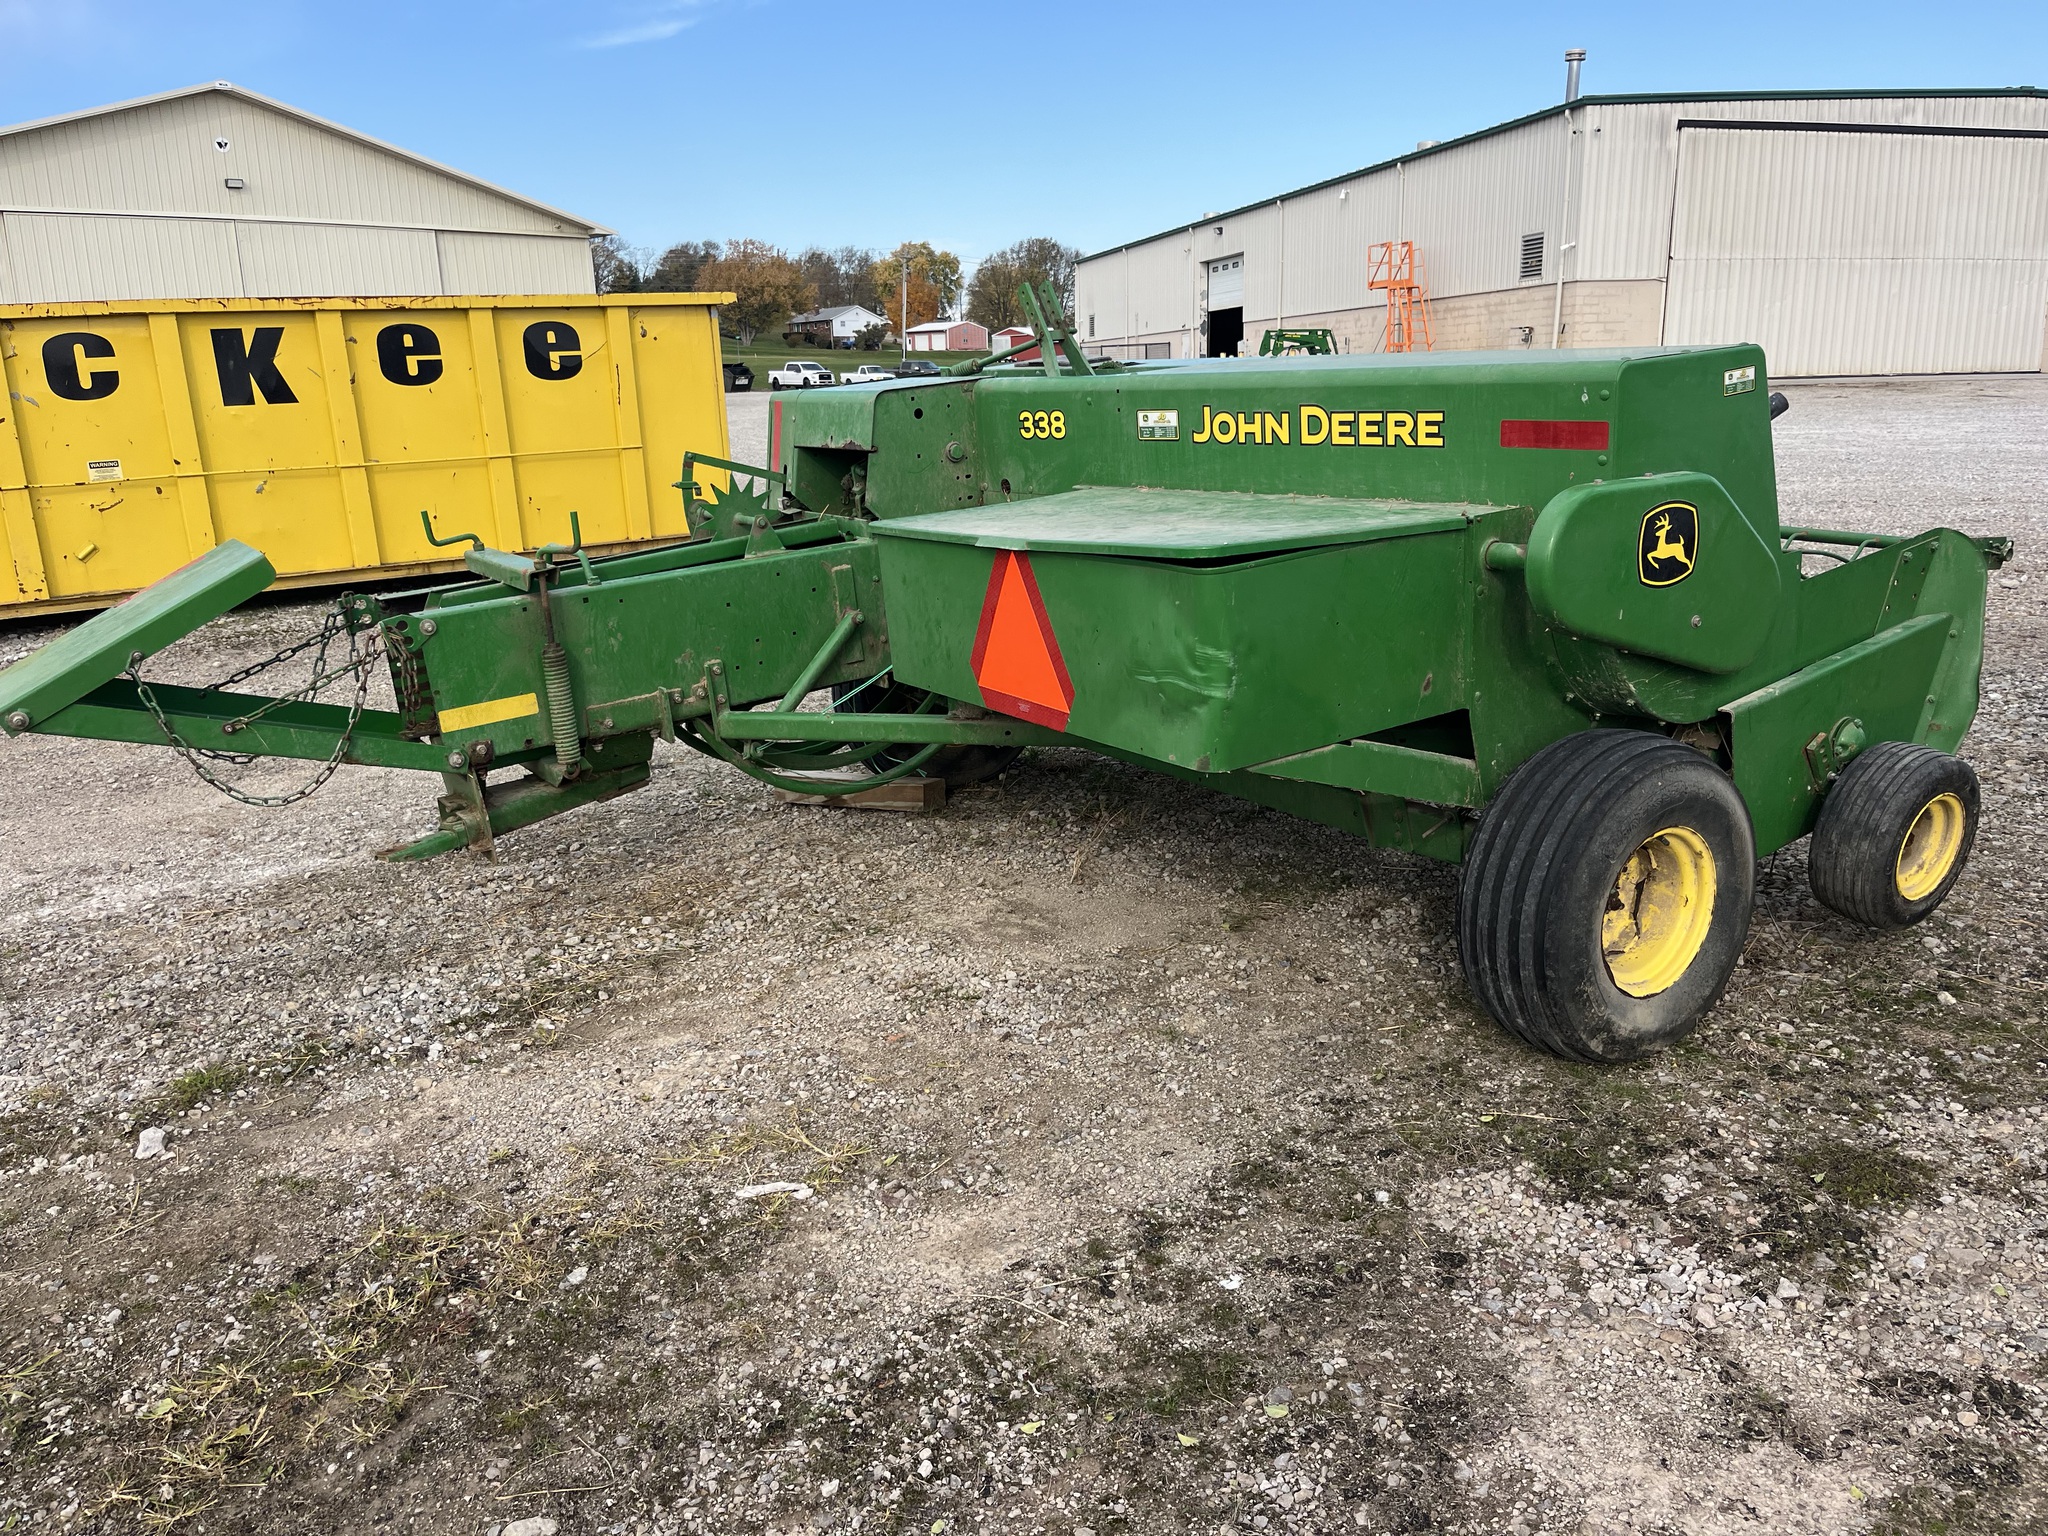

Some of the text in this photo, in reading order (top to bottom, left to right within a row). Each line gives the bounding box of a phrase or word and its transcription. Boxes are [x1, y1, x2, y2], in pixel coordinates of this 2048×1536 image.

[1019, 409, 1066, 440] 338
[1192, 404, 1445, 448] JOHN DEERE
